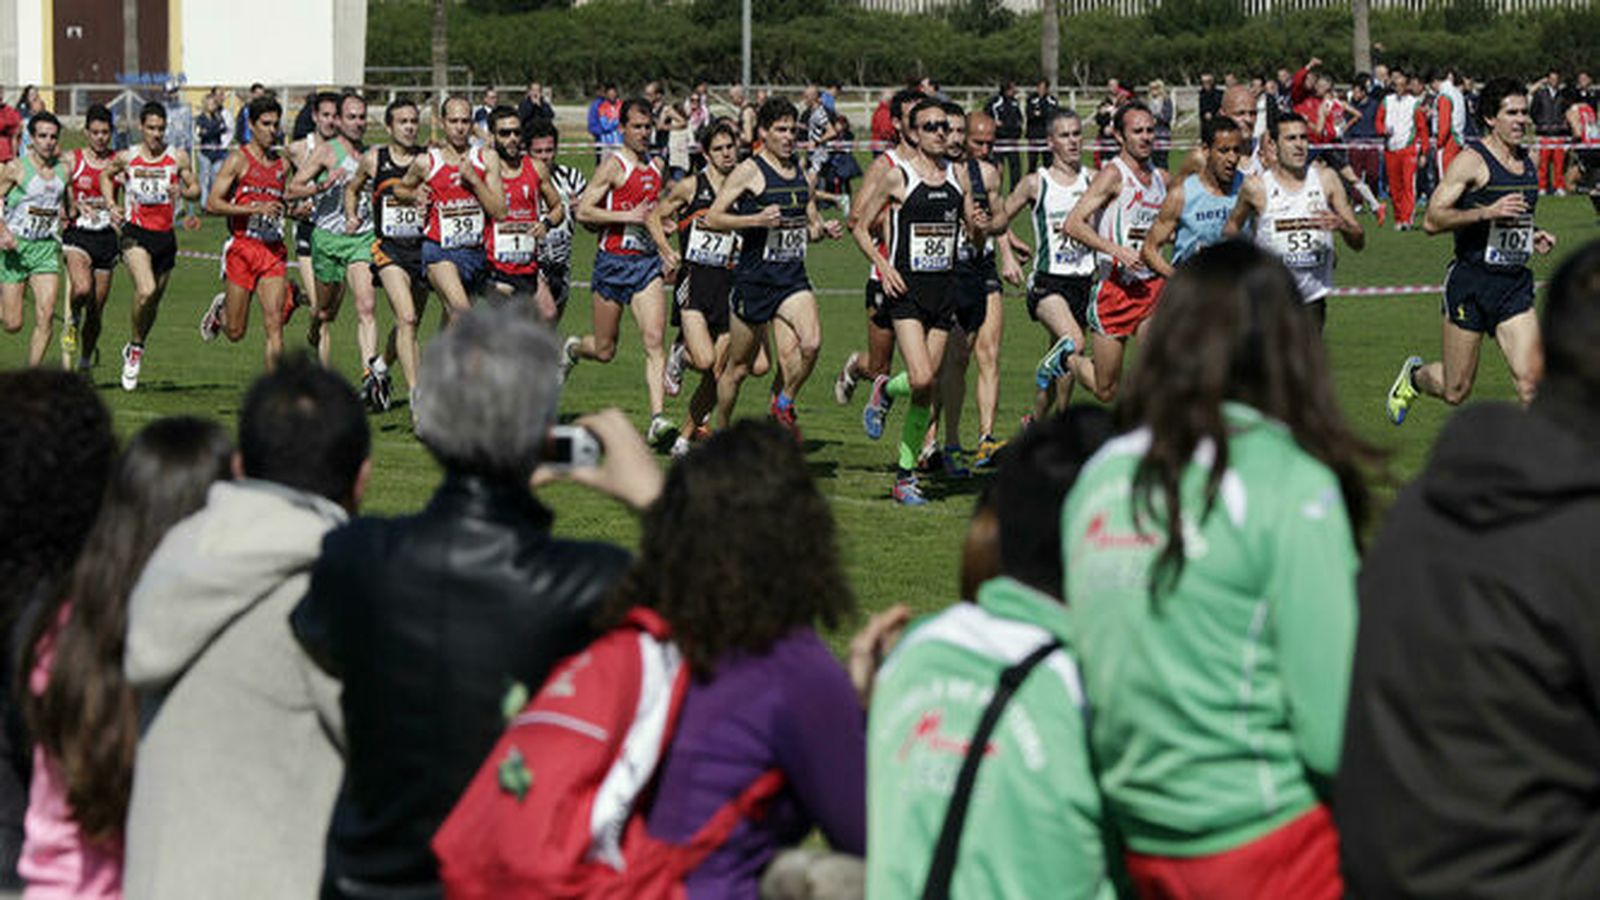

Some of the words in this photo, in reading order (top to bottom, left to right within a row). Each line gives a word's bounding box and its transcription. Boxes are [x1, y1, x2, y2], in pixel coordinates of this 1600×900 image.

[1195, 205, 1231, 222] nerj
[452, 217, 474, 235] 39
[700, 232, 723, 252] 27
[1287, 231, 1312, 253] 53
